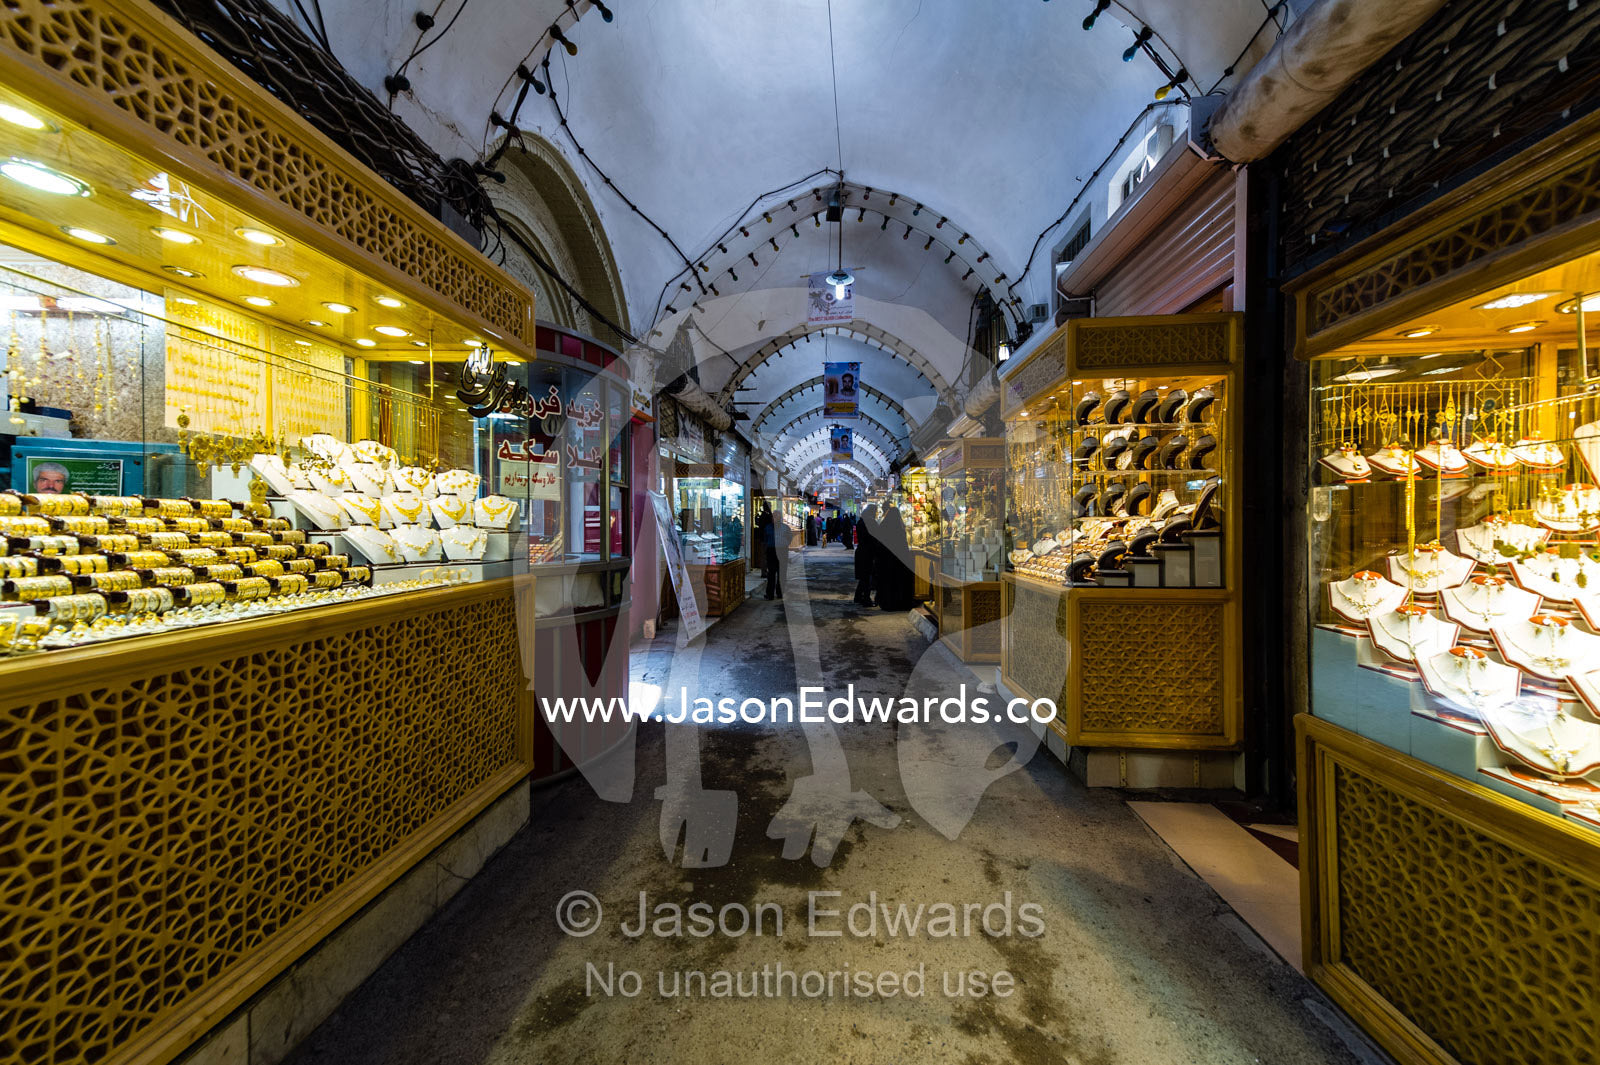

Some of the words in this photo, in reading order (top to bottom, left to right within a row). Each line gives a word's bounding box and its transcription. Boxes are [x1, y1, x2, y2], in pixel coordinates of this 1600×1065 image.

[566, 399, 604, 428] خرید
[497, 438, 560, 465] سکه
[567, 443, 603, 470] طلا
